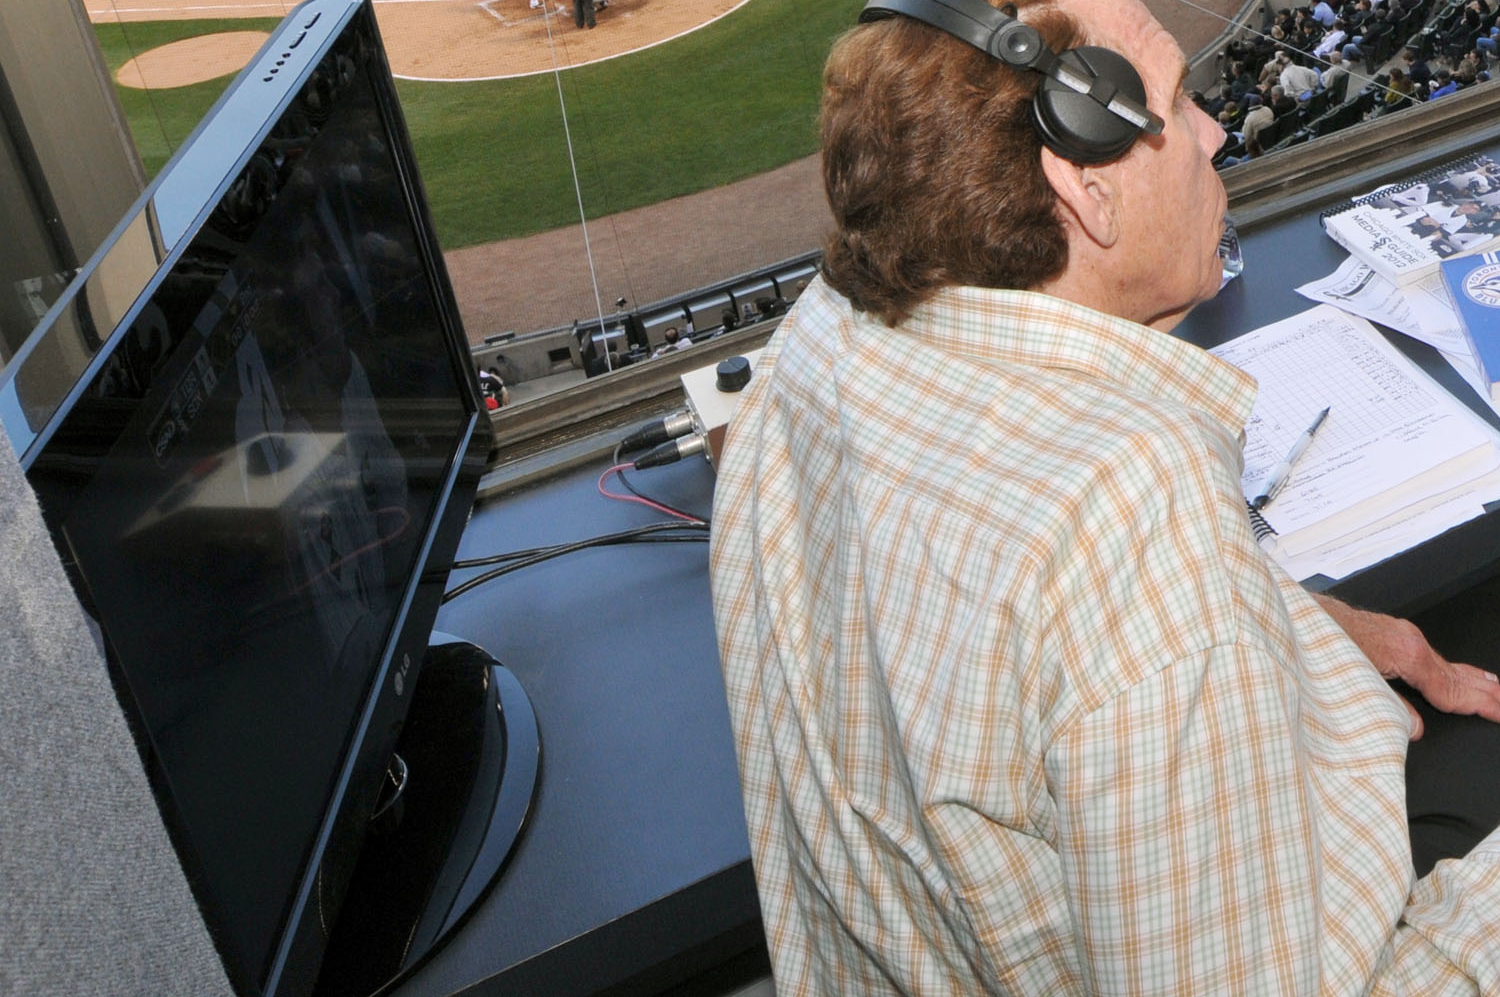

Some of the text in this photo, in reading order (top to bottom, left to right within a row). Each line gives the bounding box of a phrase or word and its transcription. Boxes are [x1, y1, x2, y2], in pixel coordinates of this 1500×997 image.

[1363, 211, 1393, 235] CHICAGO
[1352, 215, 1419, 265] MEDIA GUIDE
[1382, 252, 1407, 268] 2012
[400, 653, 411, 677] LG
